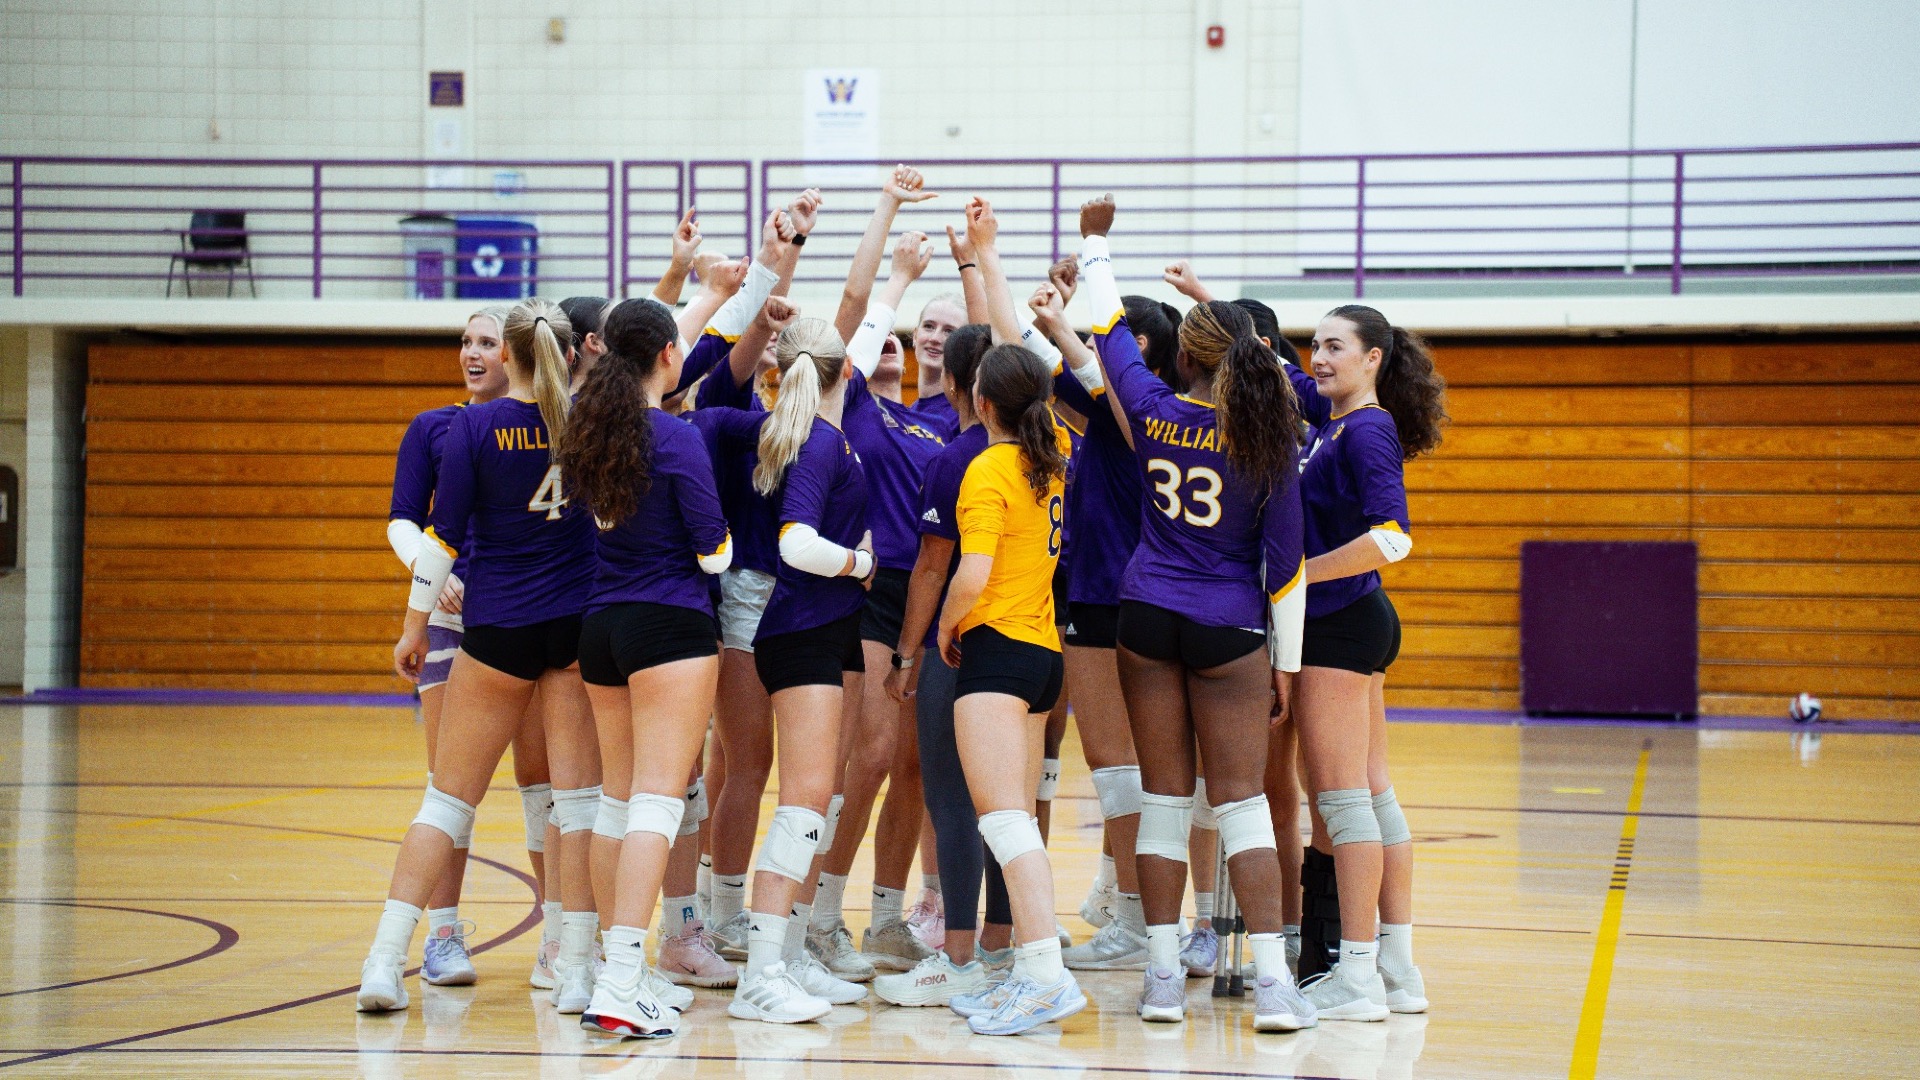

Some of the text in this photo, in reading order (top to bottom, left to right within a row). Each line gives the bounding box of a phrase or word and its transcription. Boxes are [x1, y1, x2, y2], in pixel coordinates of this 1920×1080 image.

[527, 463, 570, 521] 4
[1147, 458, 1223, 528] 33
[1047, 494, 1063, 558] 8
[914, 973, 948, 988] HOKA
